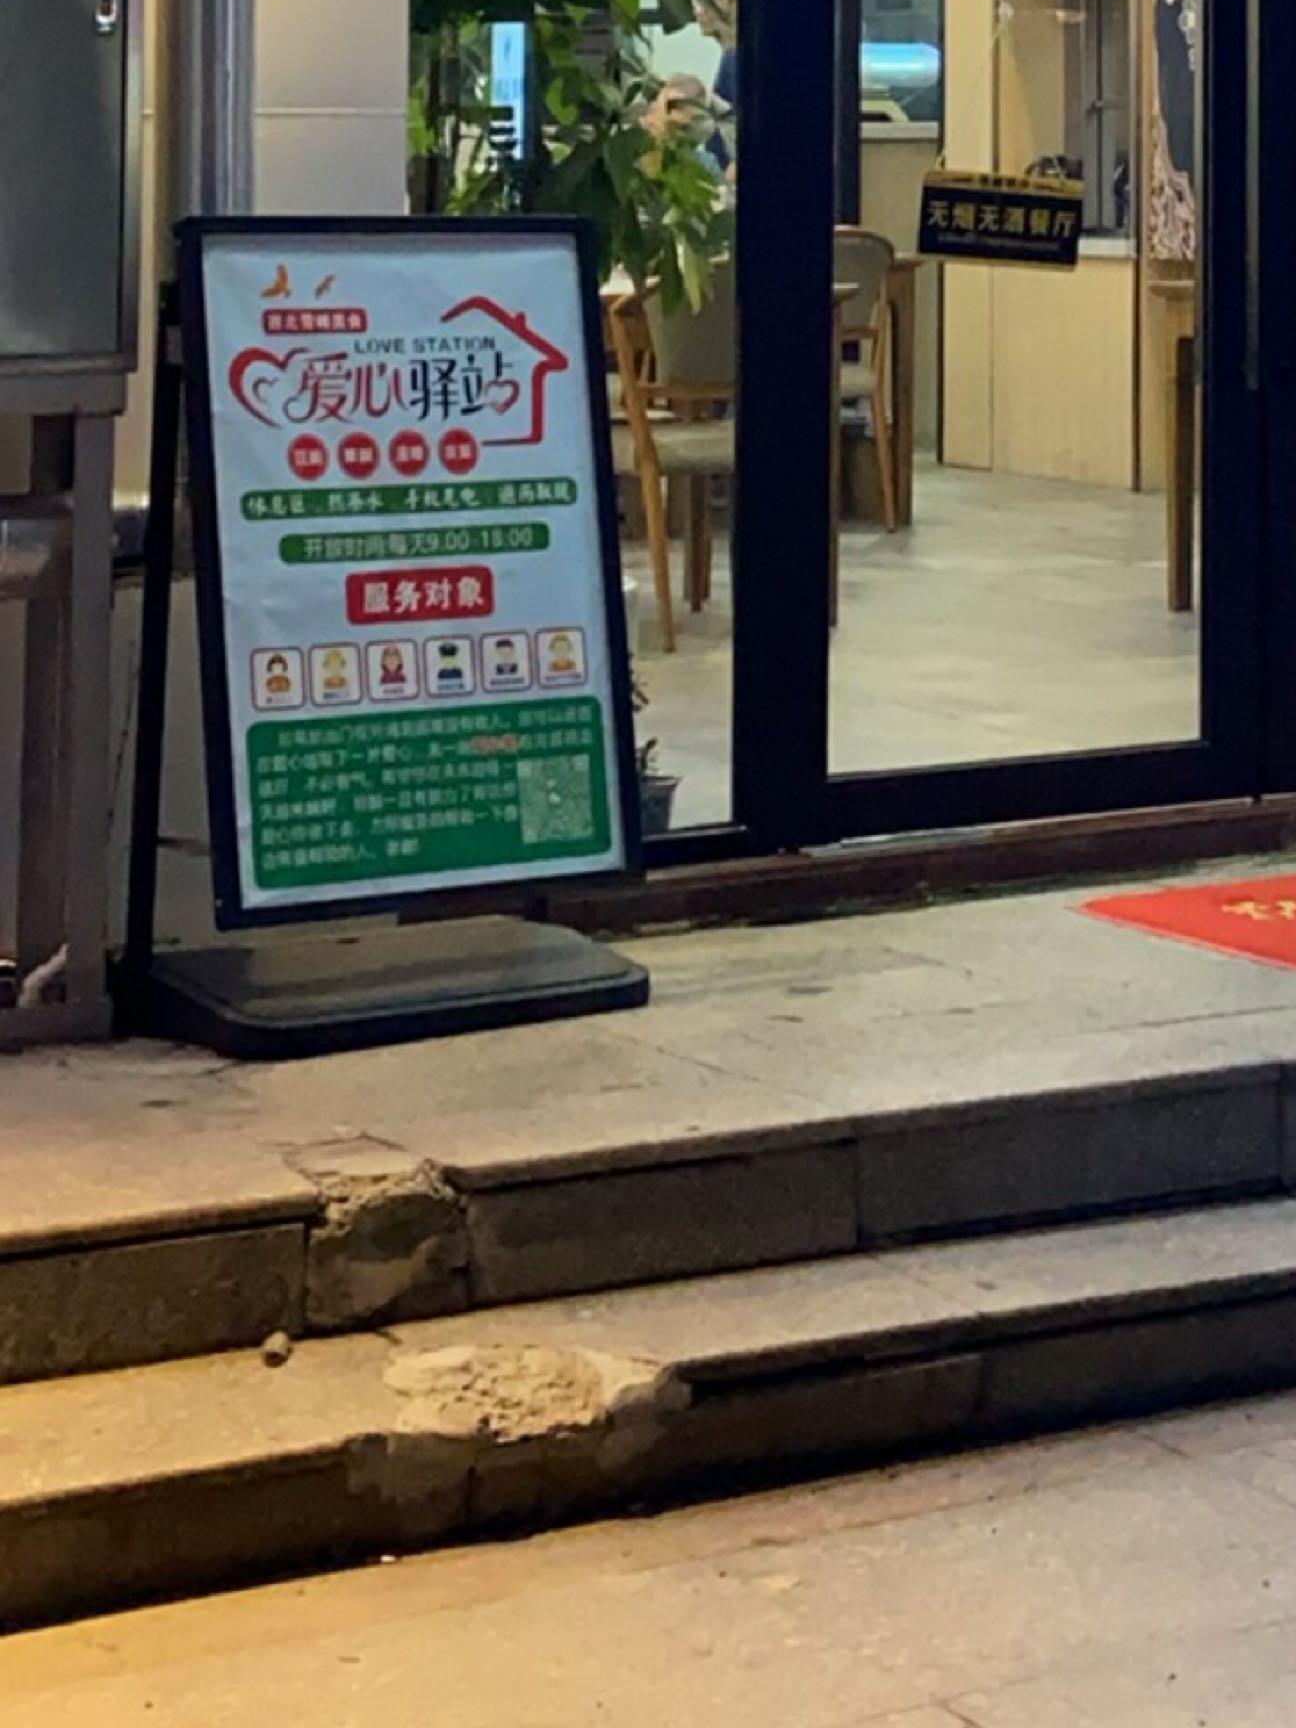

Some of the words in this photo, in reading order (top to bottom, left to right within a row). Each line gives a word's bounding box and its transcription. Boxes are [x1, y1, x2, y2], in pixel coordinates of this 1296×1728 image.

[353, 337, 405, 354] LOVE
[411, 335, 497, 353] STATION
[284, 350, 520, 423] 爱心驿站
[362, 572, 485, 614] 服务对象
